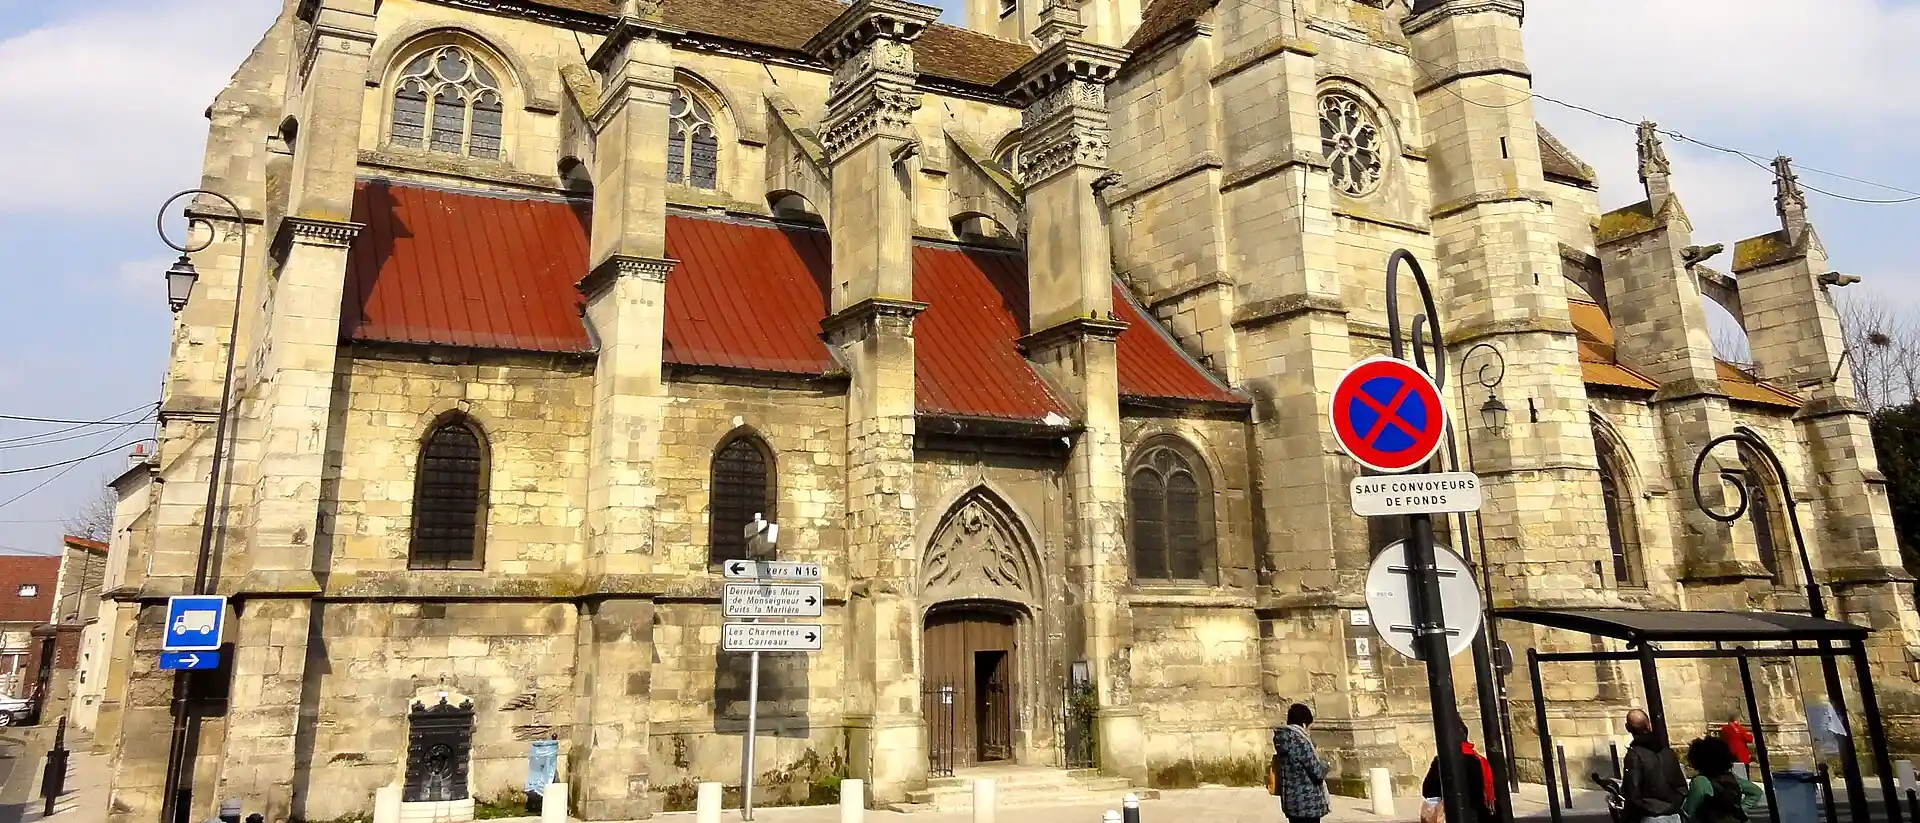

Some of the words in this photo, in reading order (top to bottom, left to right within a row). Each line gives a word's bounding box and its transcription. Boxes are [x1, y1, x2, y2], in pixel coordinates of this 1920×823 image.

[1355, 484, 1387, 494] SAUF
[1392, 480, 1475, 492] CONVOYEURS
[1386, 498, 1401, 506] DE
[1406, 495, 1447, 506] FONDS
[766, 567, 788, 575] vers
[747, 597, 800, 606] Monseigneur
